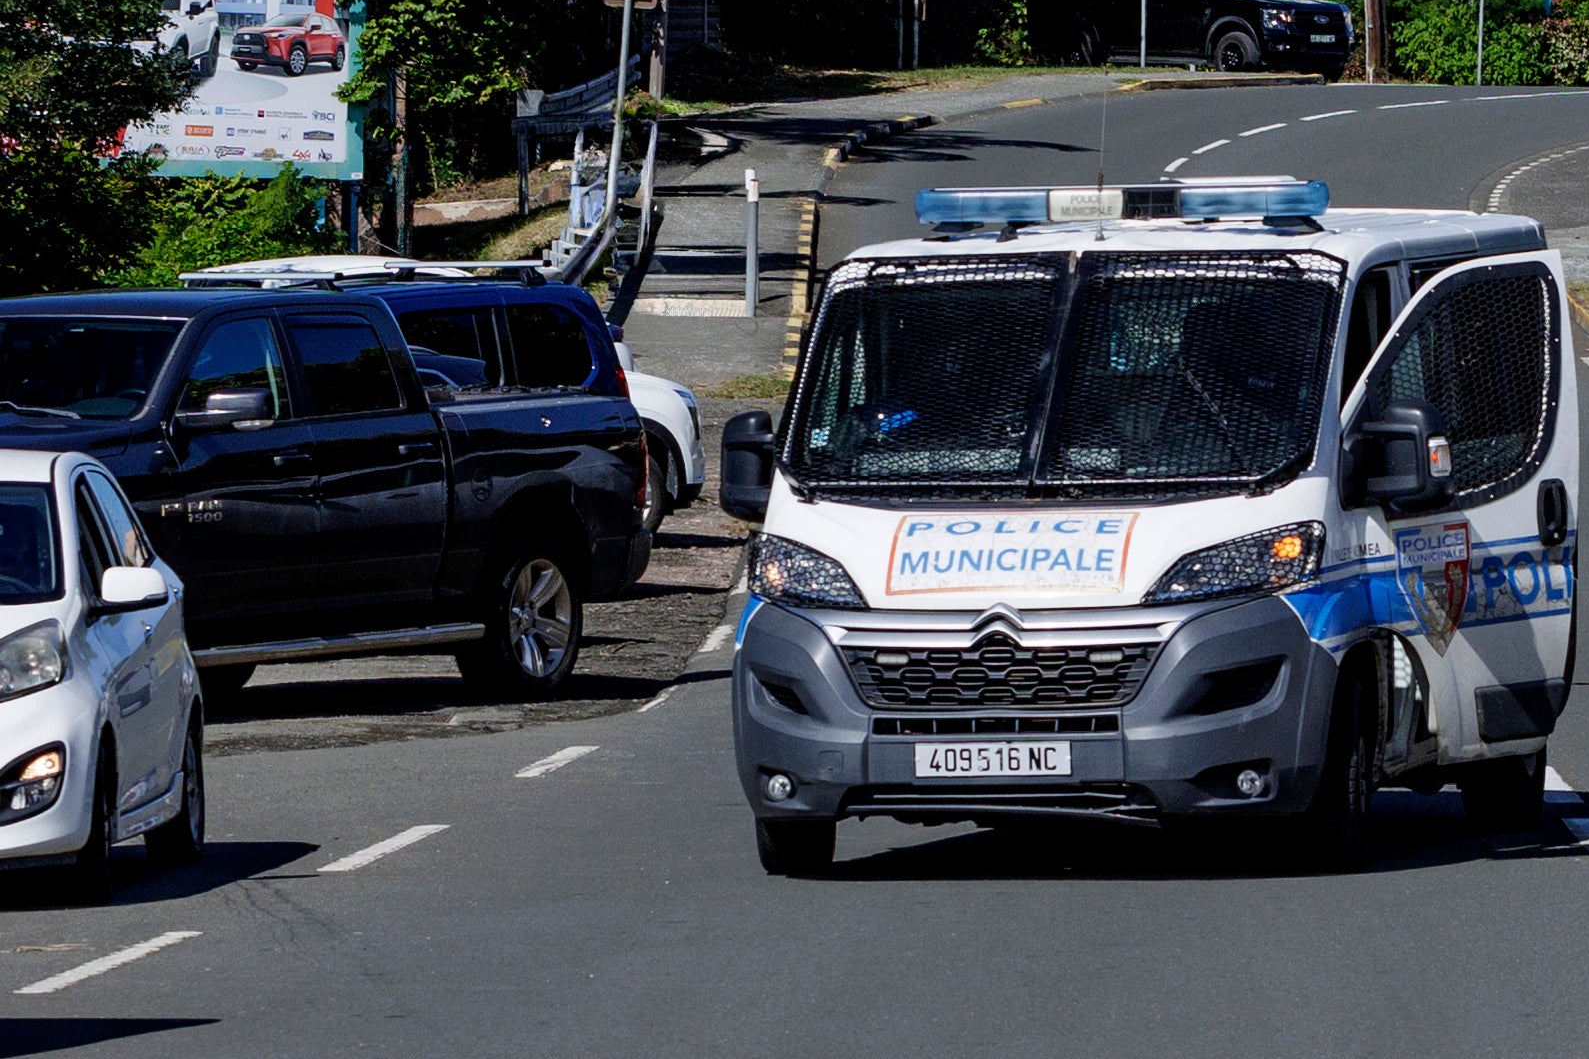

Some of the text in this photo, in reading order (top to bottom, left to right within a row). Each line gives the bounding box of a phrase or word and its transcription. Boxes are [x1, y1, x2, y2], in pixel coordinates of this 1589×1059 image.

[1071, 195, 1102, 204] POLICE
[1061, 206, 1112, 216] MUNICIPALE
[906, 519, 1122, 538] POLICE
[1402, 532, 1464, 551] POLICE
[900, 548, 1115, 575] MUNICIPALE
[1403, 548, 1465, 564] MUNICIPALE
[929, 747, 1057, 772] 409516 NC
